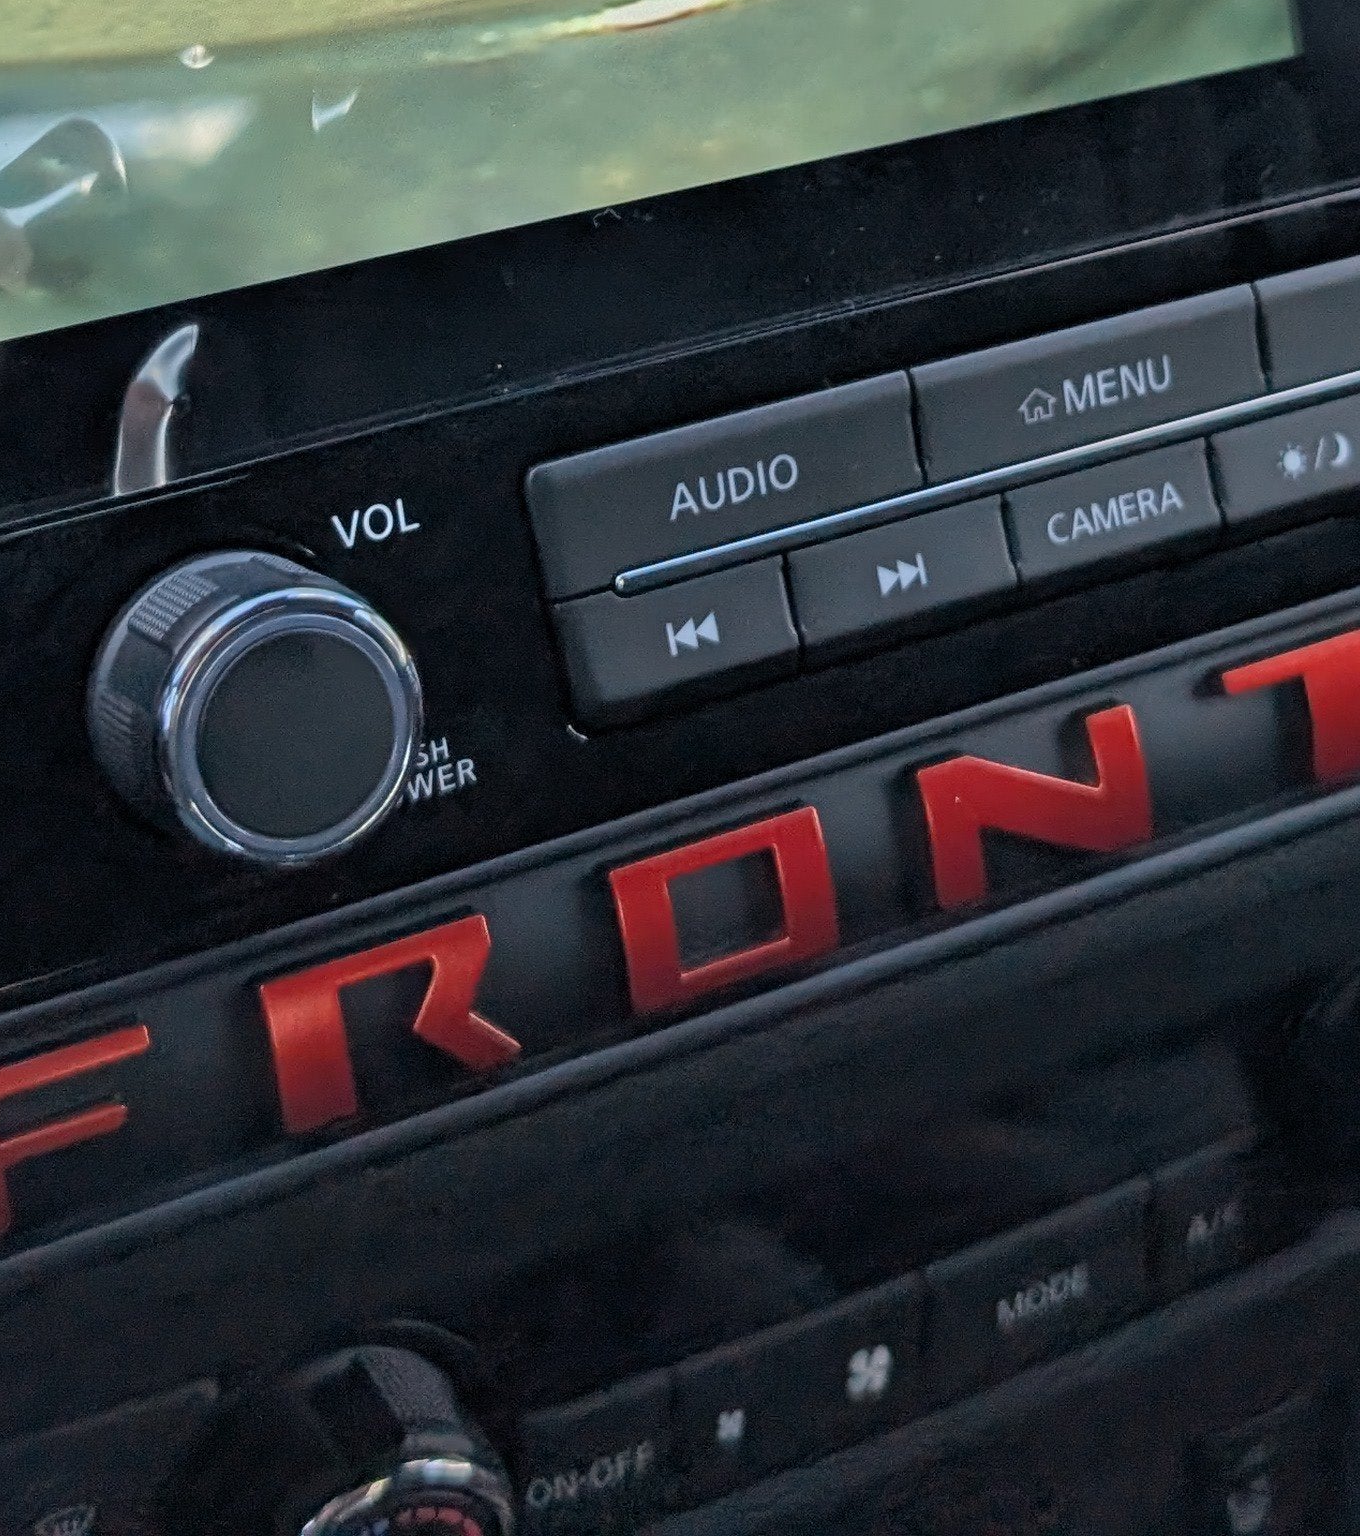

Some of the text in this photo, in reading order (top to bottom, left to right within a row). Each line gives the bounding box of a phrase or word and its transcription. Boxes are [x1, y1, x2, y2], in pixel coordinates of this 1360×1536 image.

[1061, 355, 1174, 417] MENU
[668, 451, 800, 522] AUDIO
[1046, 479, 1183, 546] CAMERA
[330, 497, 421, 549] VOL
[405, 757, 478, 804] WER
[415, 736, 451, 769] SH
[995, 1263, 1090, 1327] MODE
